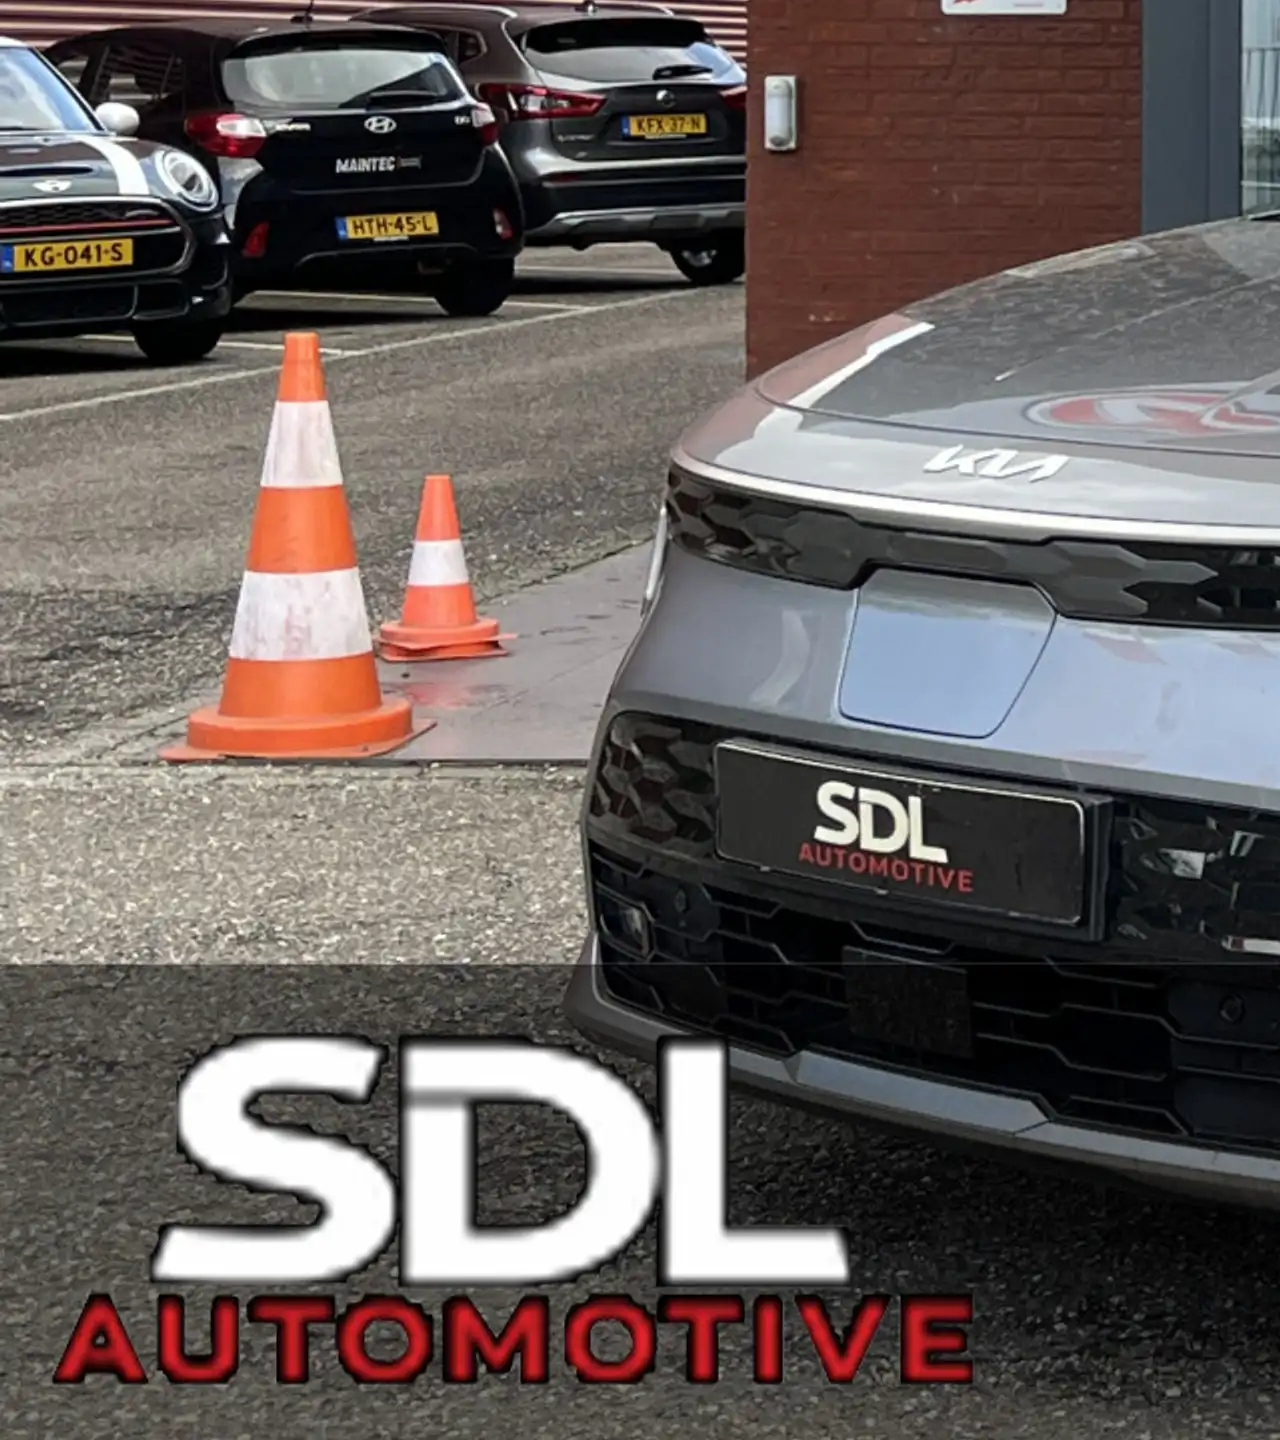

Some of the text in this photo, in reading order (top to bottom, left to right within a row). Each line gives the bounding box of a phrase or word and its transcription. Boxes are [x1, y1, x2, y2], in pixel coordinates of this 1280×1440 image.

[335, 156, 396, 174] MAINTEC
[352, 216, 433, 236] HTH-45-L
[24, 243, 123, 267] KG-041-S
[923, 444, 1070, 483] KIA
[814, 780, 948, 863] SDL
[798, 841, 974, 892] AUTOMOTIVE
